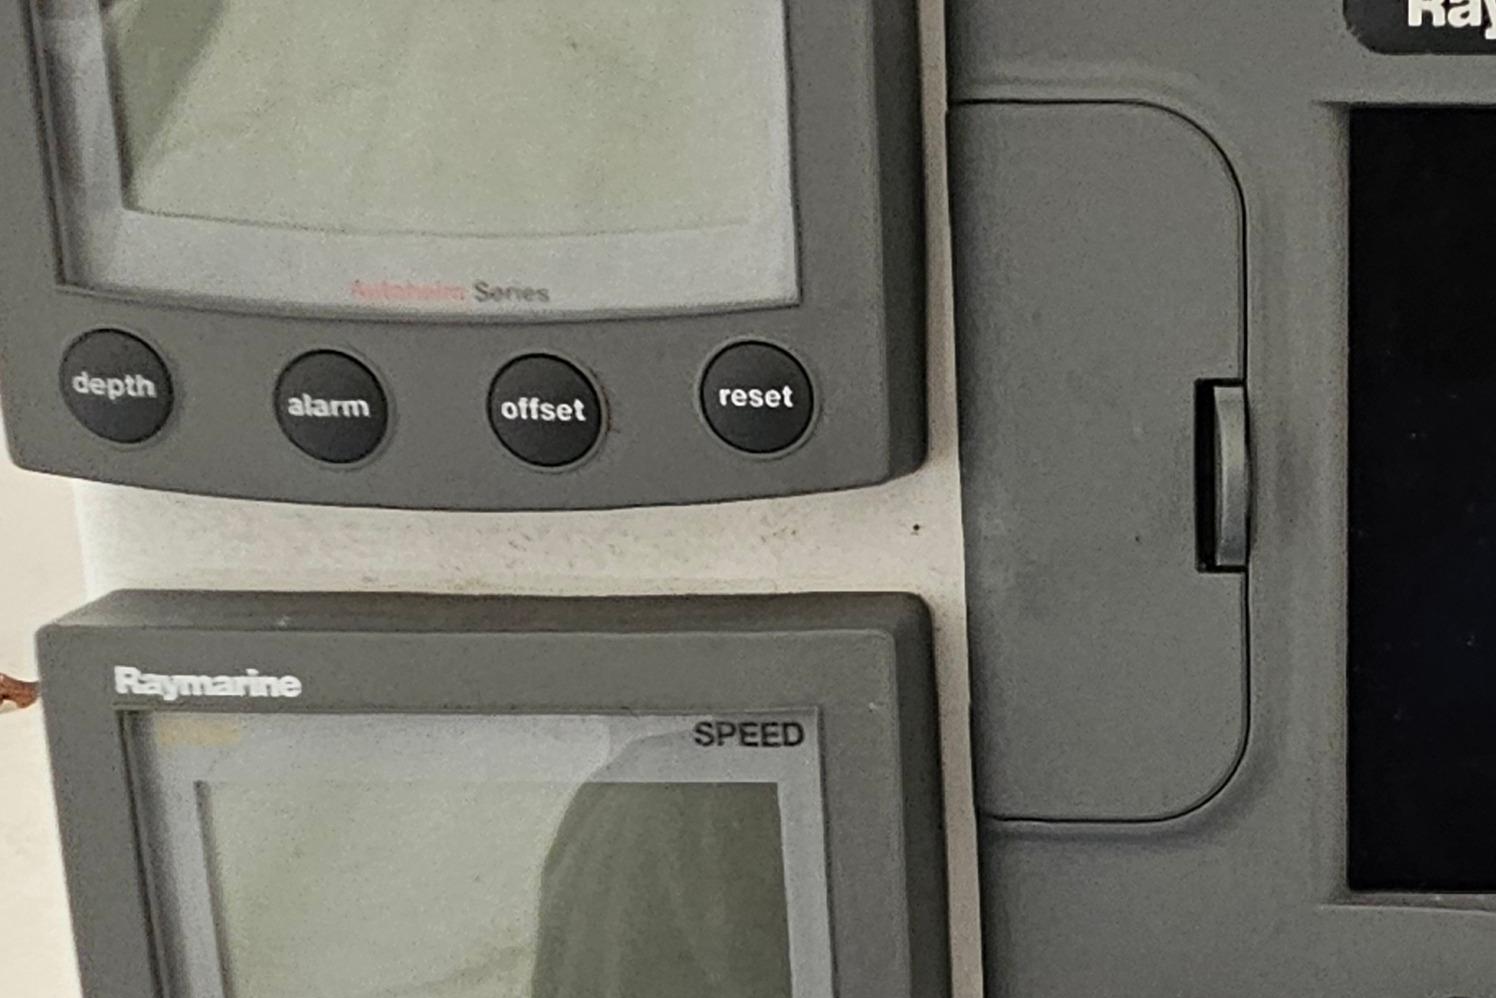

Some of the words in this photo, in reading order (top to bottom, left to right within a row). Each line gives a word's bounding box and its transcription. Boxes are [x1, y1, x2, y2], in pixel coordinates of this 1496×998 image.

[71, 370, 157, 401] depth
[718, 384, 795, 409] reset
[287, 392, 372, 418] alarm
[500, 396, 587, 422] offset
[113, 664, 303, 702] Raymarine
[693, 721, 806, 747] SPEED
